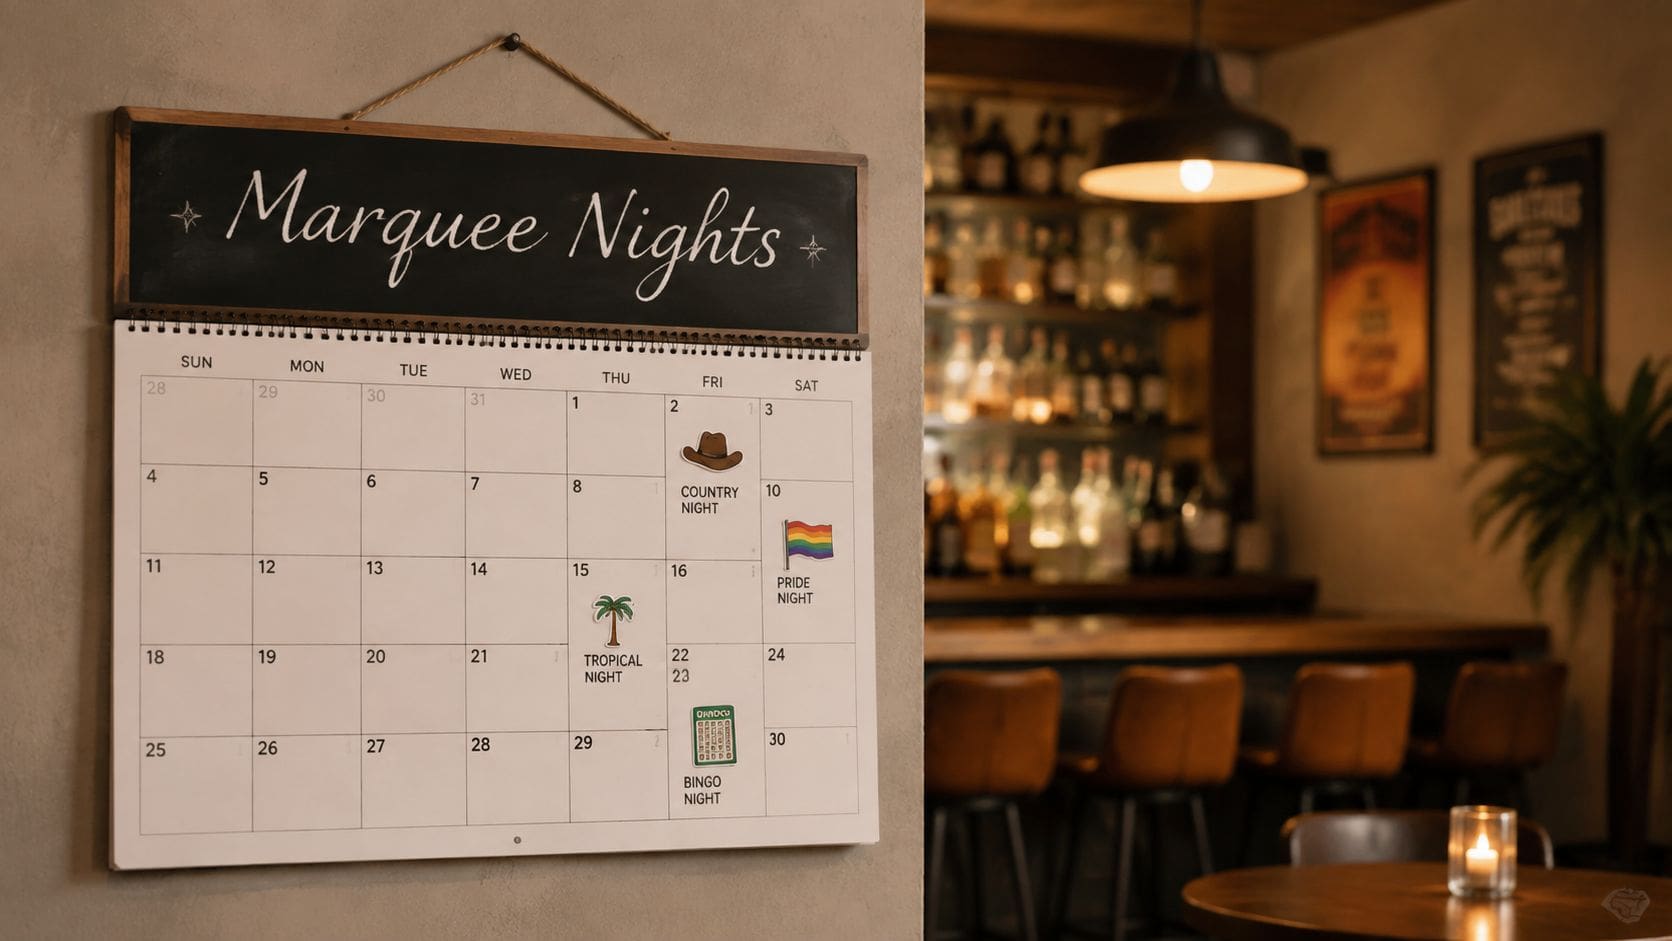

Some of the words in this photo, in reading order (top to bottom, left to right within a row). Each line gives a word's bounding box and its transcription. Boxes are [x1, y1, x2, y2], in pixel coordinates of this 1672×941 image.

[226, 169, 548, 288] Marquee
[569, 188, 780, 301] Nights
[181, 354, 213, 369] SUN
[290, 359, 325, 373] MON
[399, 363, 428, 377] TUE
[499, 367, 532, 381] WED
[601, 371, 630, 385] THU
[702, 375, 723, 388] FRI
[794, 378, 819, 392] SAT
[147, 380, 166, 396] 28
[258, 384, 279, 399] 29
[367, 388, 386, 403] 30
[470, 392, 485, 406] 31
[572, 395, 578, 410] 1
[670, 399, 679, 413] 2
[764, 402, 773, 416] 3
[146, 468, 158, 483] 4
[258, 471, 269, 486] 5
[366, 473, 377, 489] 6
[470, 476, 480, 491] 7
[572, 479, 582, 494] 8
[765, 483, 781, 498] 10
[680, 485, 739, 499] COUNTRY
[681, 501, 719, 514] NIGHT
[146, 558, 161, 573] 11
[258, 559, 276, 574] 12
[366, 560, 384, 575] 13
[470, 561, 488, 576] 14
[572, 562, 589, 577] 15
[671, 563, 688, 578] 16
[777, 576, 811, 589] PRIDE
[777, 591, 814, 604] NIGHT
[146, 649, 165, 665] 18
[258, 649, 277, 665] 19
[366, 648, 386, 664] 20
[470, 648, 487, 664] 21
[583, 654, 643, 667] TROPICAL
[671, 648, 689, 662] 22
[767, 647, 786, 662] 24
[584, 670, 623, 684] NIGHT
[366, 738, 386, 754] 27
[471, 736, 491, 752] 28
[574, 735, 593, 750] 29
[769, 732, 786, 746] 30
[145, 742, 166, 758] 25
[257, 740, 278, 756] 26
[683, 775, 722, 789] BINGO
[684, 791, 721, 805] NIGHT
